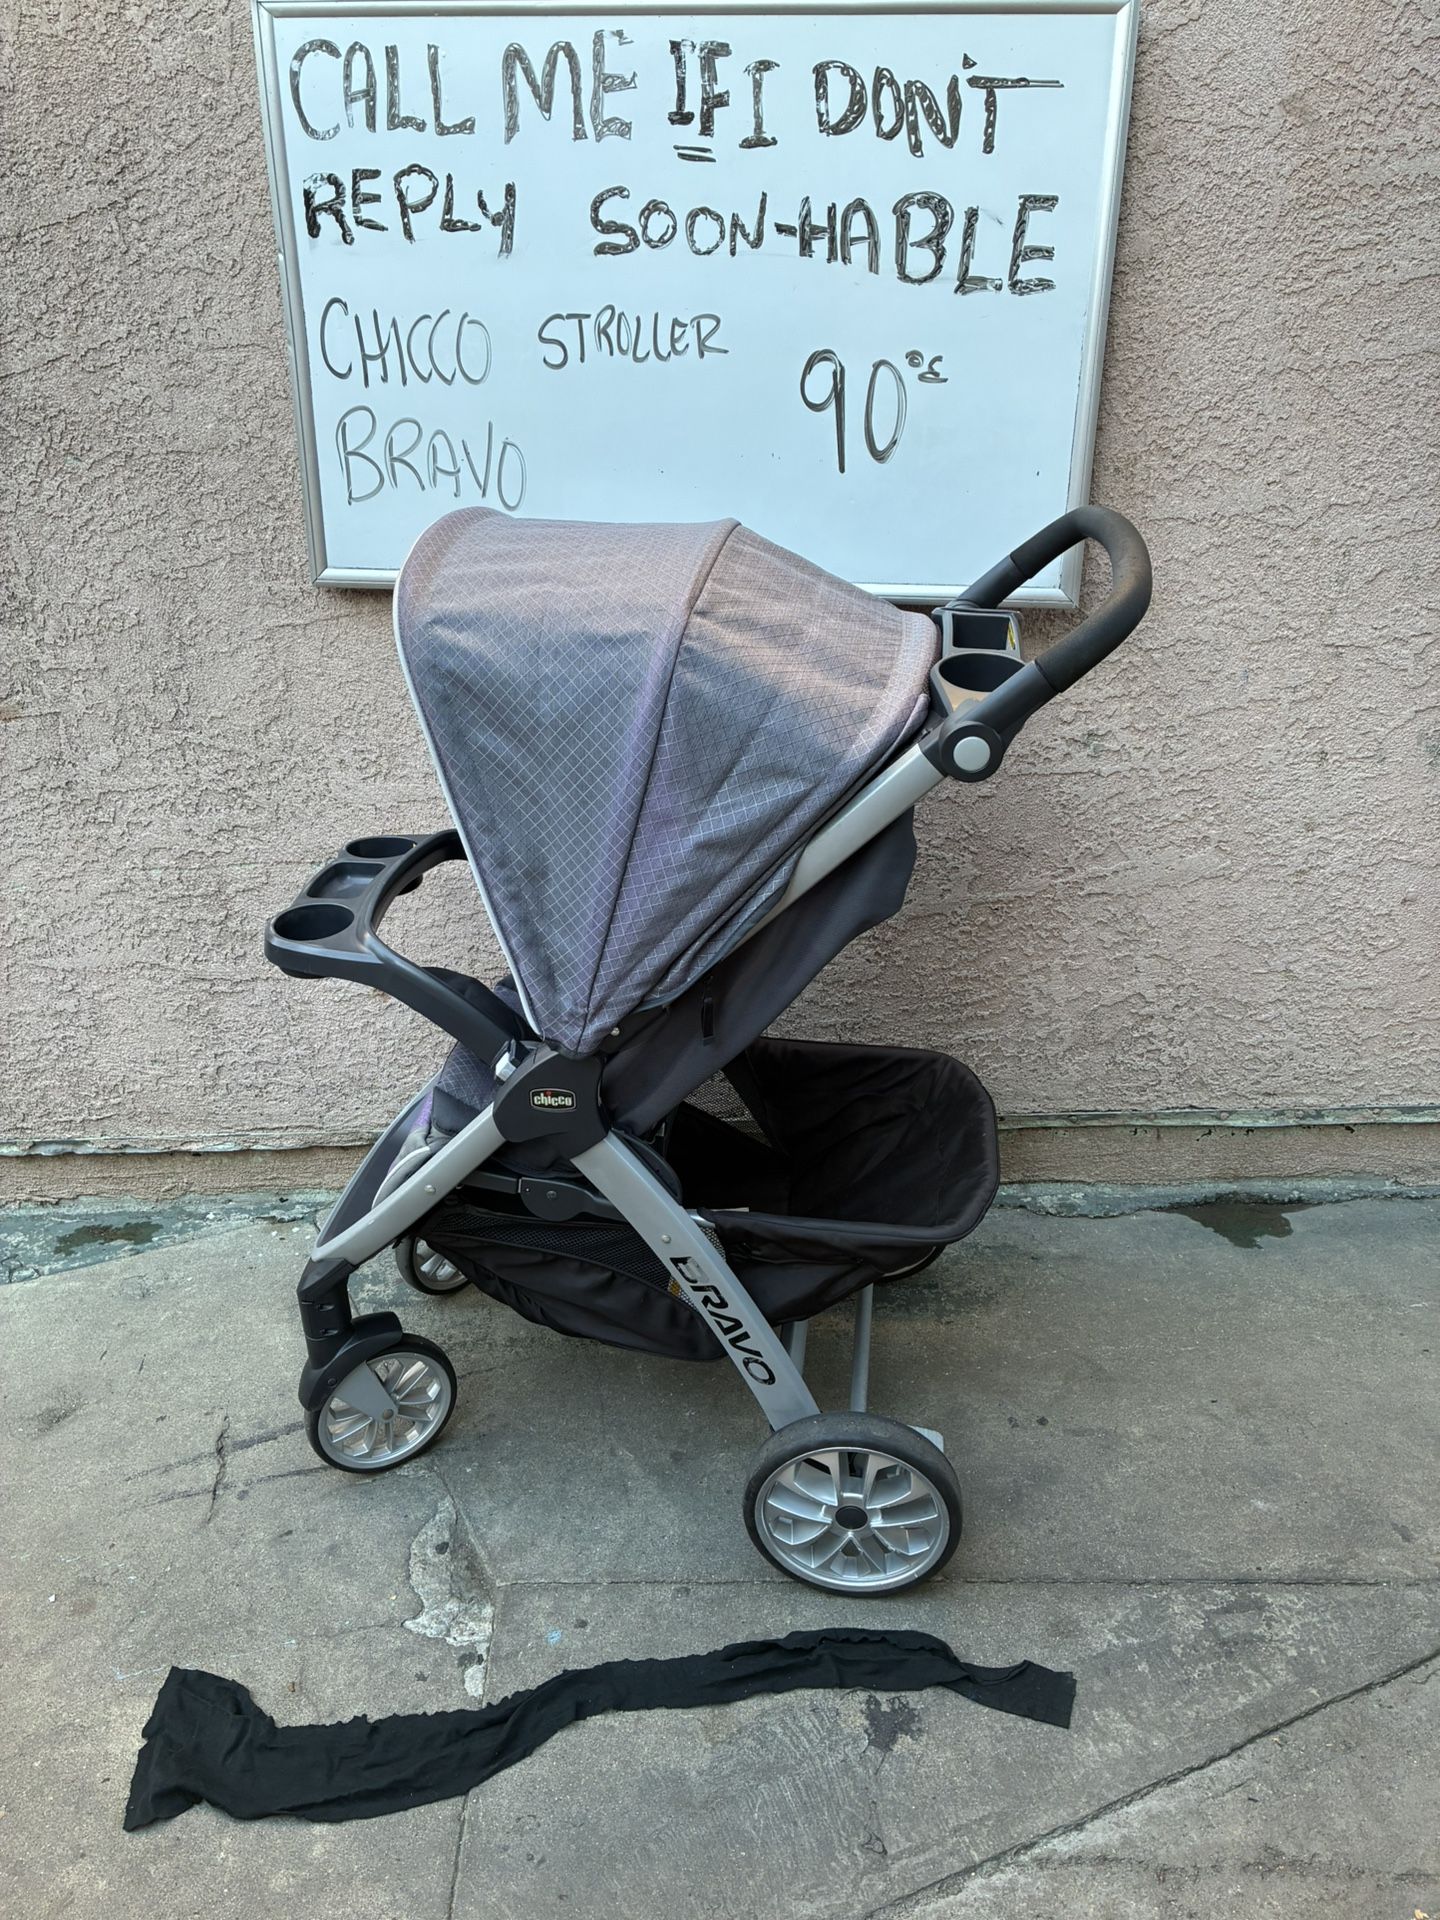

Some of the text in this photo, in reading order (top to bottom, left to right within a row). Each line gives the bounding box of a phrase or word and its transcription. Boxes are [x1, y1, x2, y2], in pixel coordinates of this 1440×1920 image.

[290, 29, 1065, 158] CALL ME IF I DON'T
[303, 163, 517, 260] REPLY
[320, 297, 729, 388] CHICCO STROLLER
[335, 405, 528, 512] BRAVO
[533, 1090, 573, 1107] chicco
